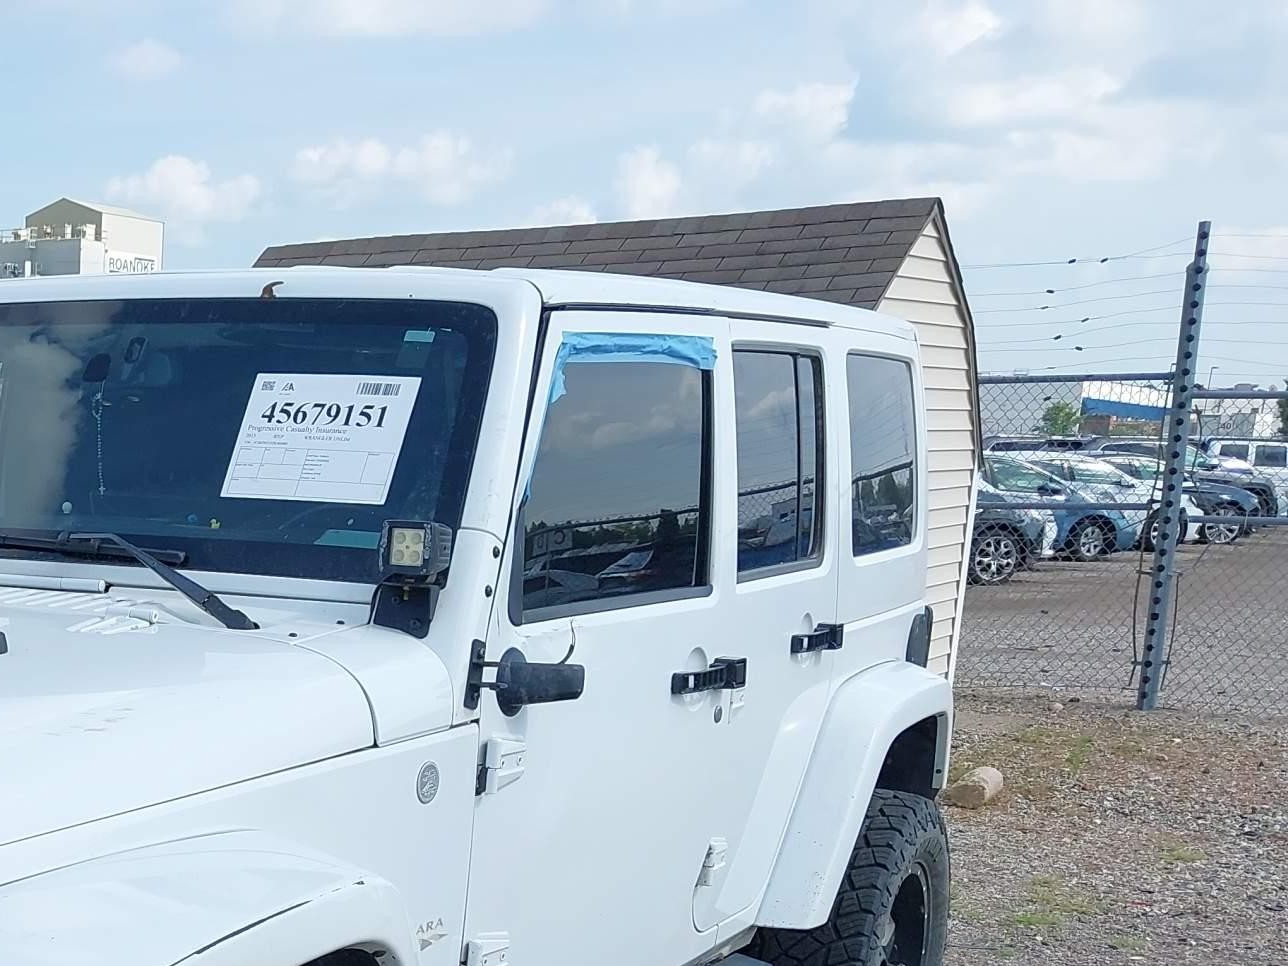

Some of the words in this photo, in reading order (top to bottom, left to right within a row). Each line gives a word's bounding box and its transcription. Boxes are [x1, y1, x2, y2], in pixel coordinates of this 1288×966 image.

[109, 257, 155, 272] ROANOKE
[261, 401, 388, 427] 45679151
[248, 424, 285, 434] Progressive
[286, 426, 314, 435] Casualty
[316, 426, 348, 435] Insurance
